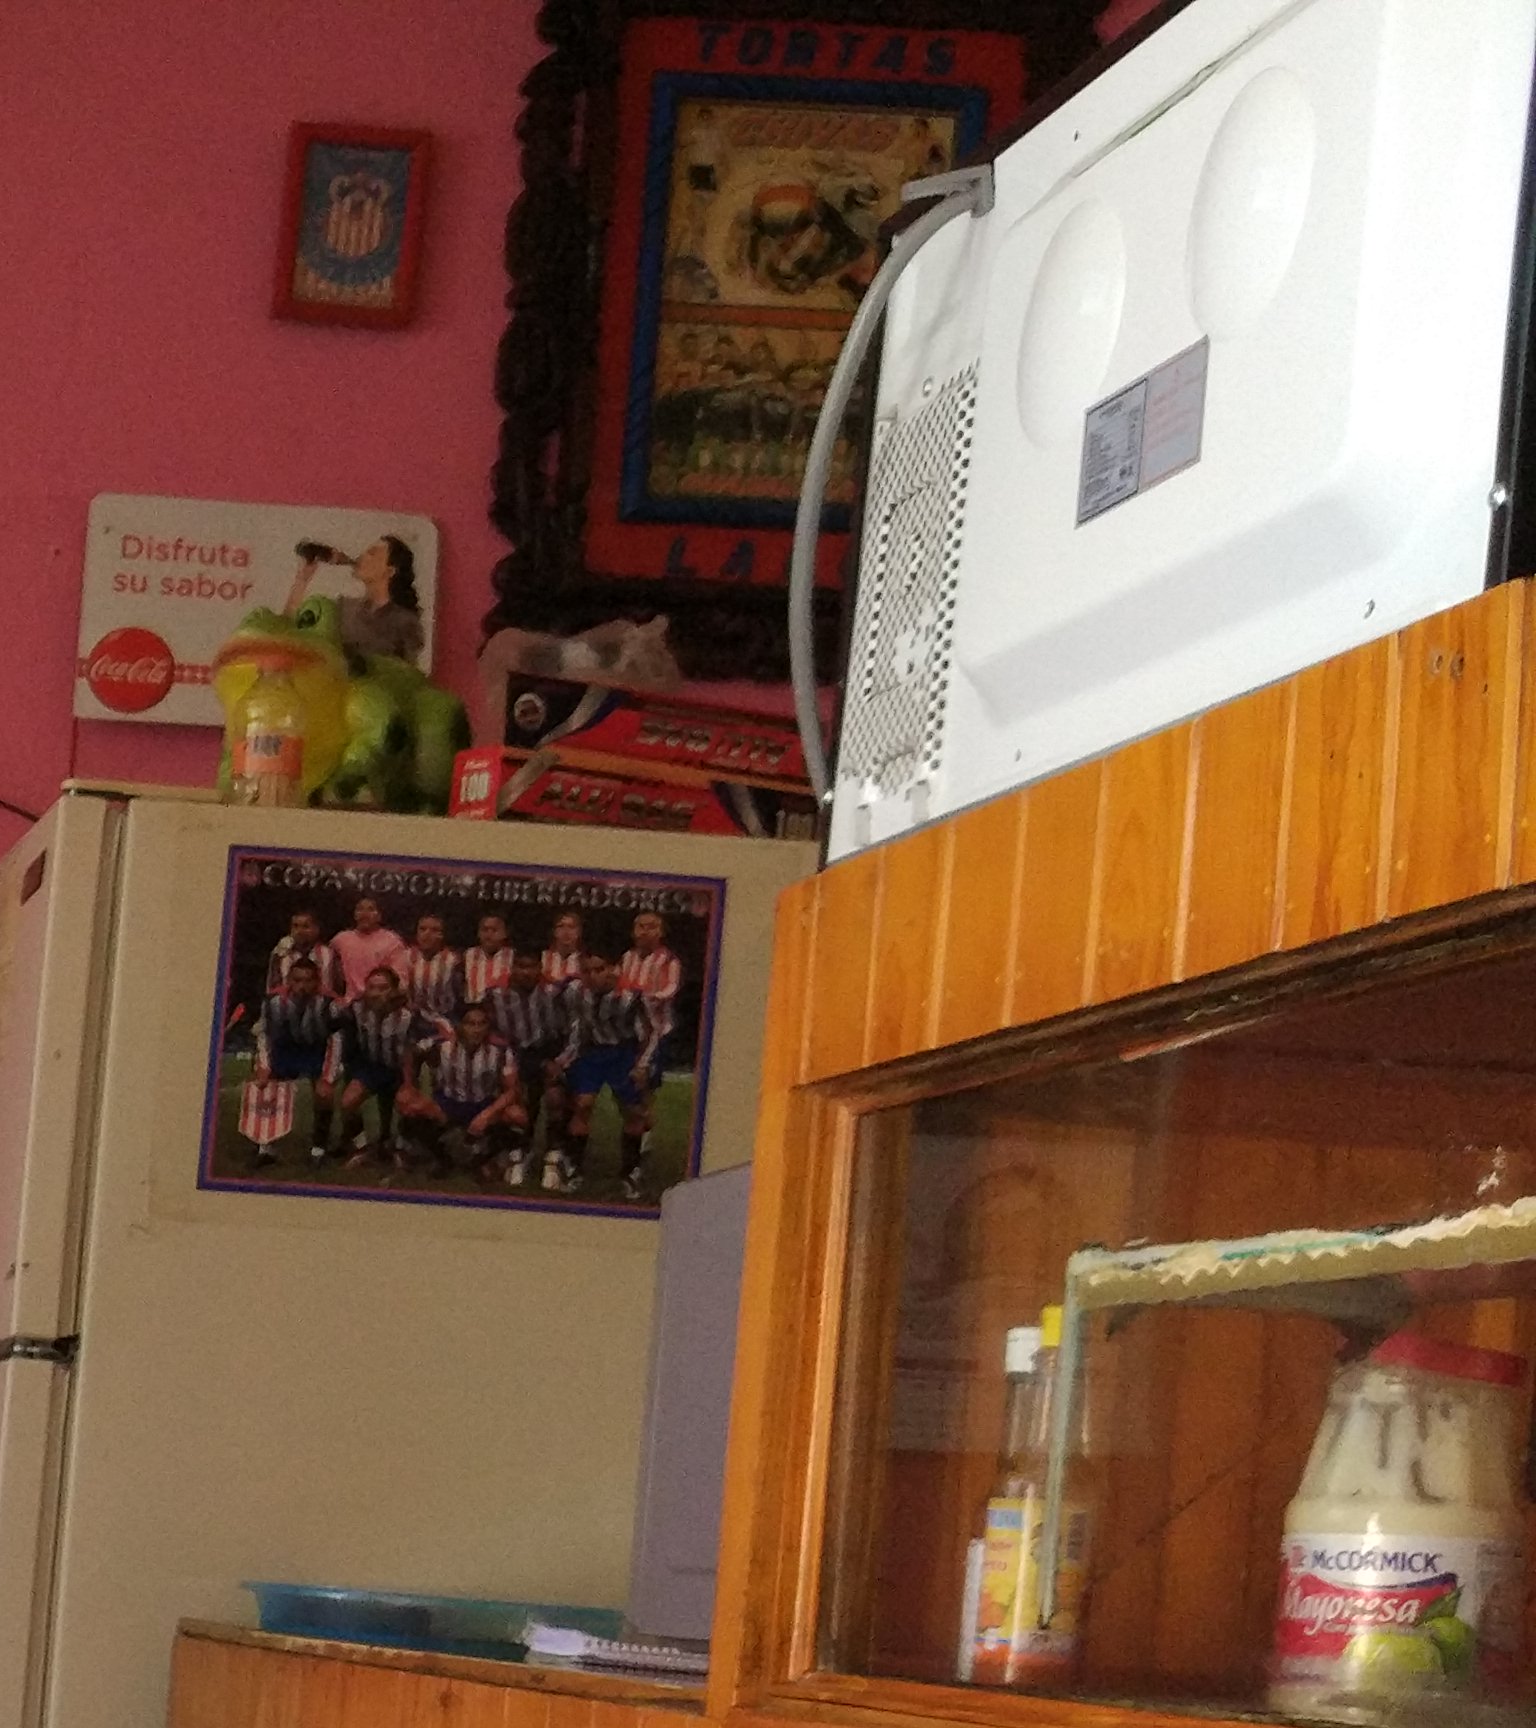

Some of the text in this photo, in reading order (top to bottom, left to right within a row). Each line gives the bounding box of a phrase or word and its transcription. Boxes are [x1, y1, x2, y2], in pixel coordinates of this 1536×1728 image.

[697, 23, 957, 76] TORTAS
[120, 533, 251, 568] Disfruta
[112, 573, 254, 600] su sabor
[89, 653, 171, 684] Coca-Cola
[261, 863, 340, 892] COPA
[476, 878, 691, 916] LIBERTADORES
[1310, 1549, 1442, 1574] McCORMICK
